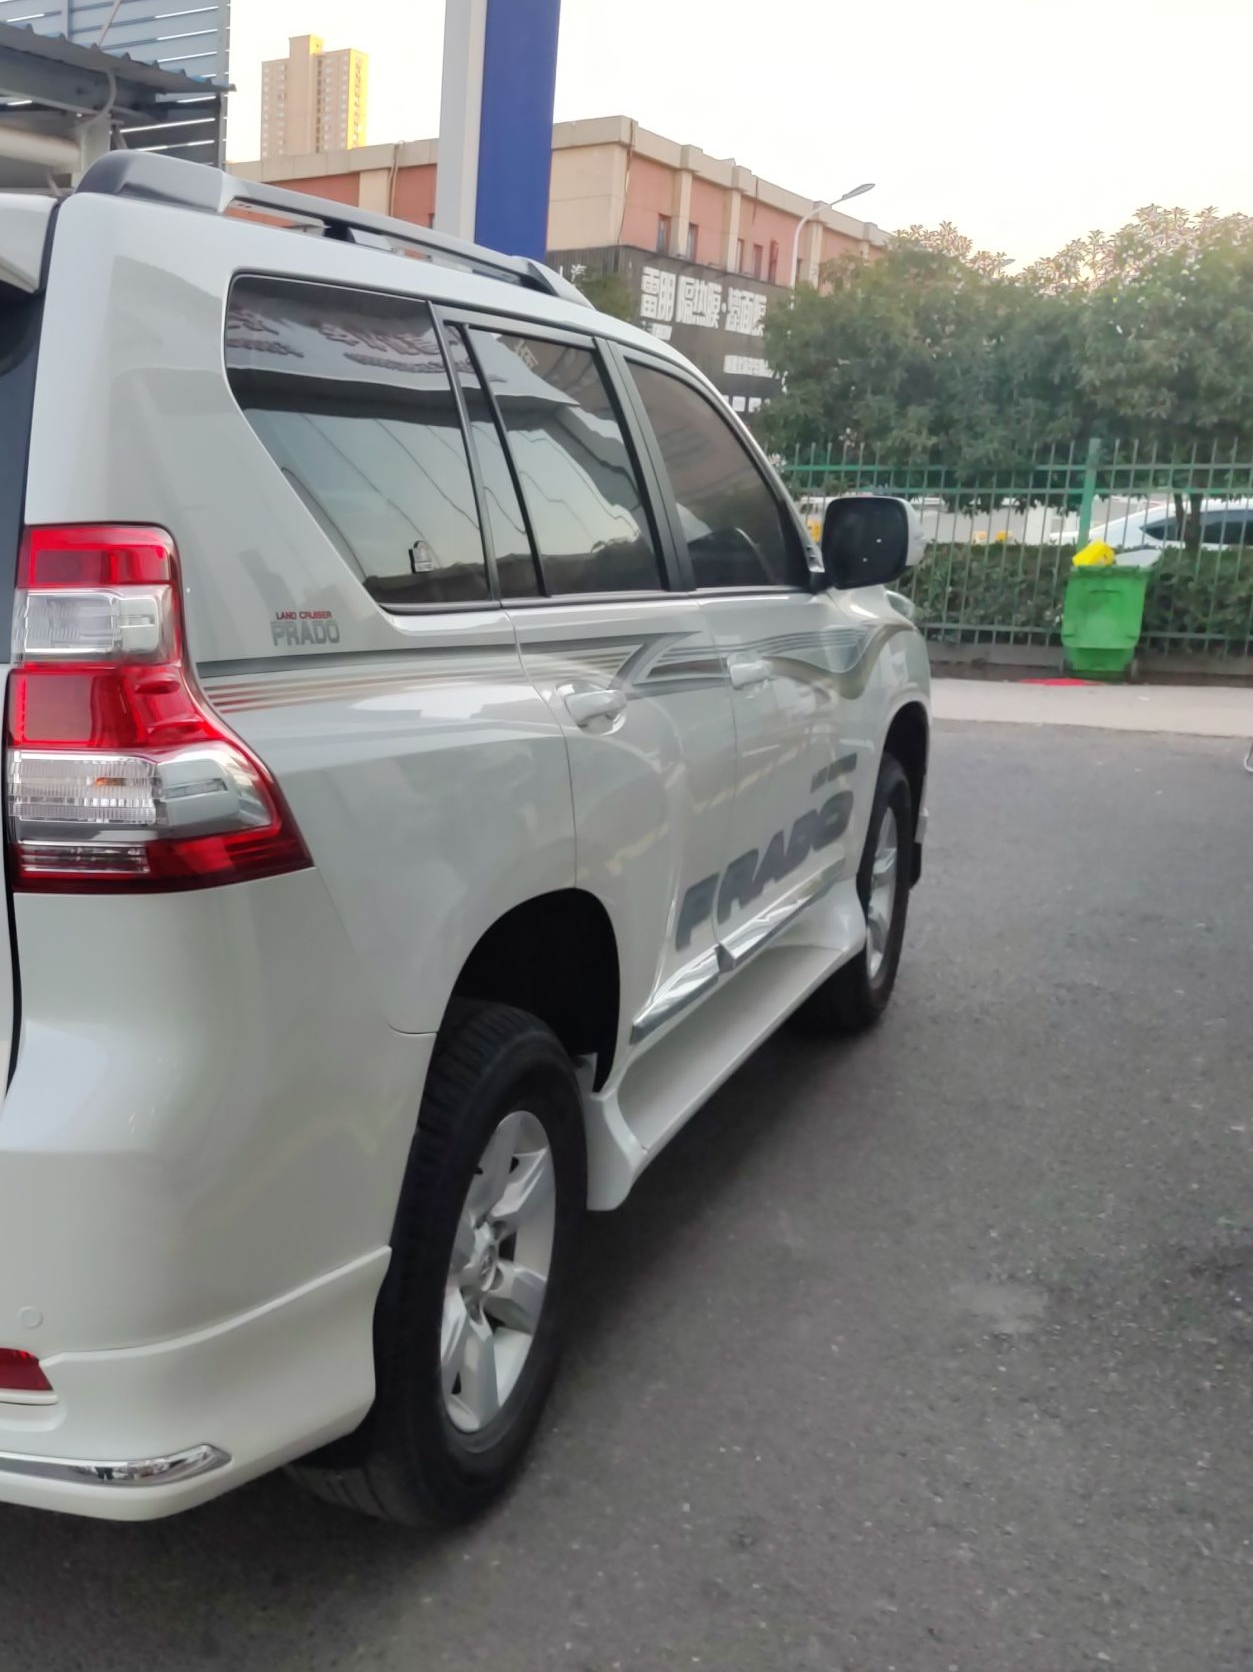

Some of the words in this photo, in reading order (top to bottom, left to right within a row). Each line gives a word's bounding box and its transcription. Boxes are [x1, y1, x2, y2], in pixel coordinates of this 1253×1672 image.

[275, 611, 297, 620] LAND
[299, 610, 333, 620] CRUISER
[270, 620, 340, 646] PRADO
